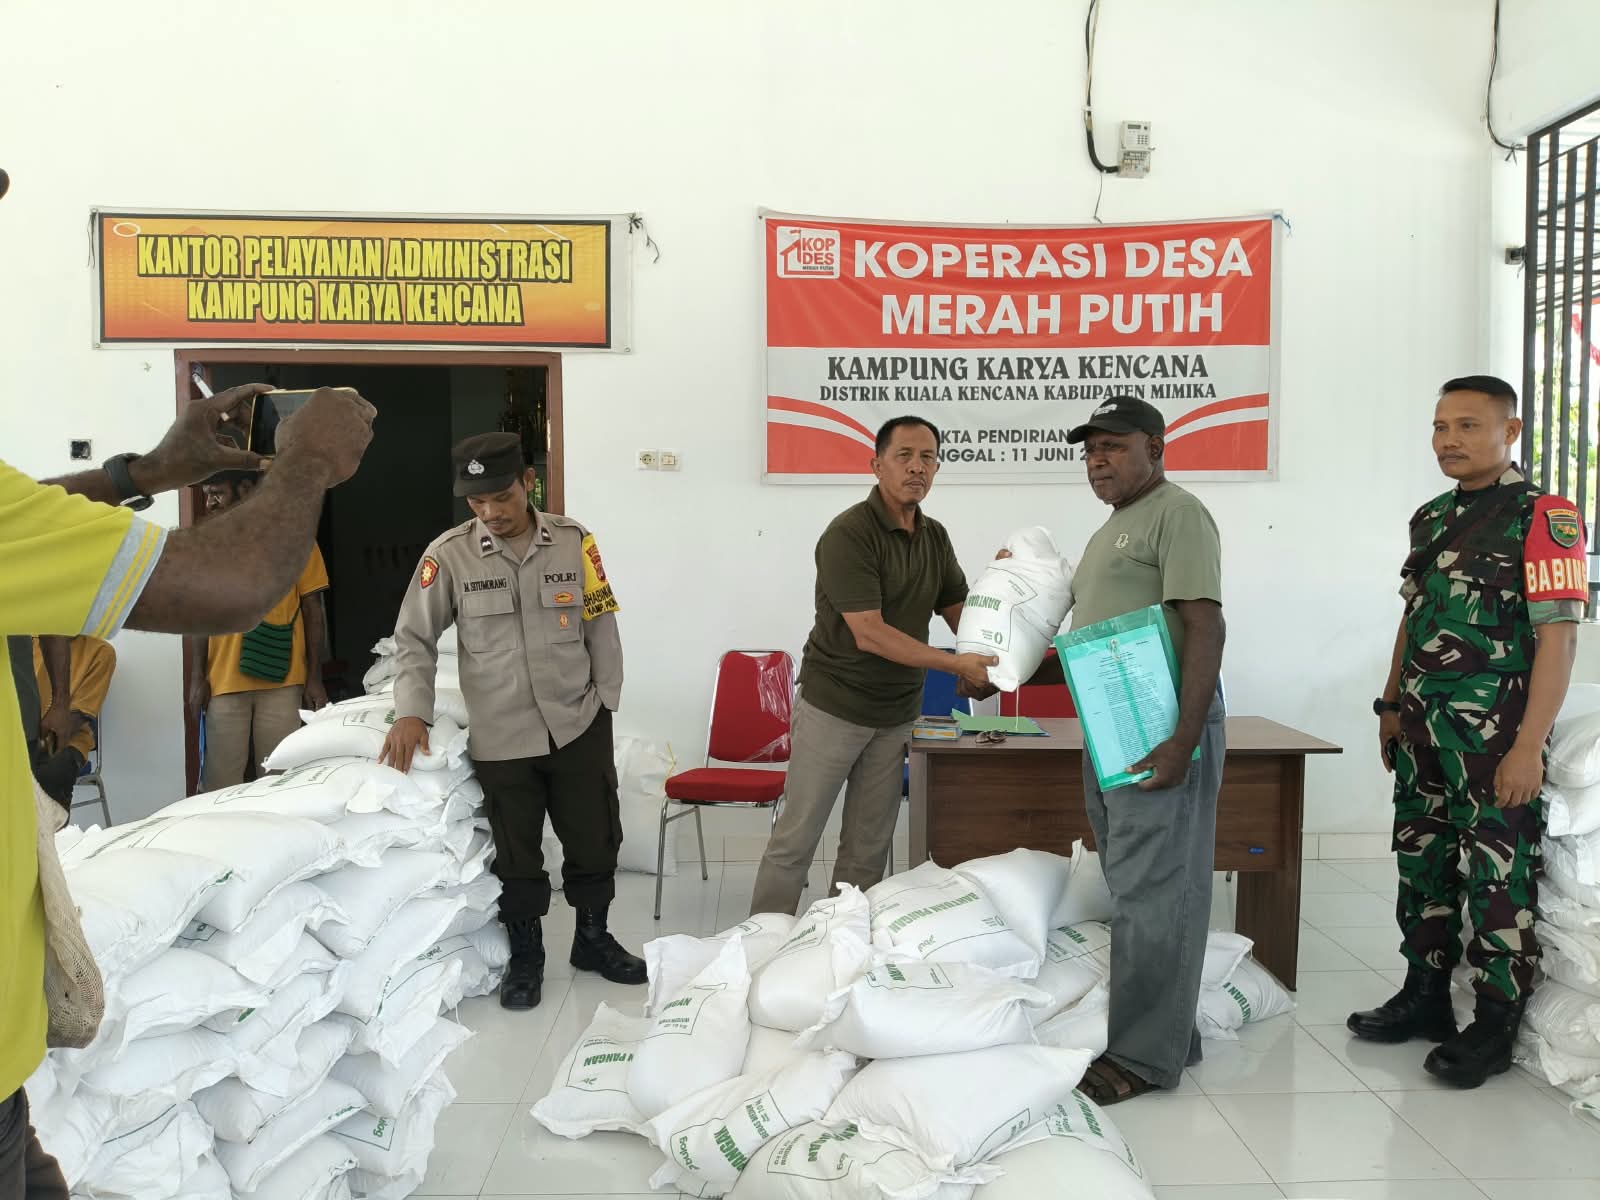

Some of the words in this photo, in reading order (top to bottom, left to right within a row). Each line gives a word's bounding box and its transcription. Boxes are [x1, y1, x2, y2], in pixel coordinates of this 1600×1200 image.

[802, 238, 836, 251] KOP
[137, 235, 241, 278] KANTOR
[243, 236, 383, 280] PELAYANAN
[386, 238, 572, 283] ADMINISTRASI
[802, 252, 835, 265] DES
[854, 239, 1106, 279] KOPERASI
[1124, 237, 1253, 278] DESA
[187, 281, 315, 322] KAMPUNG
[318, 282, 403, 324] KARYA
[405, 284, 524, 326] KENCANA
[881, 293, 1061, 335] MERAH
[1079, 292, 1223, 333] PUTIH
[827, 356, 970, 381] KAMPUNG
[976, 356, 1069, 381] KARYA
[1078, 354, 1209, 380] KENCANA
[820, 386, 890, 402] DISTRIK
[895, 386, 952, 402] KUALA
[957, 385, 1040, 402] KENCANA
[1044, 384, 1146, 401] KABUPATEN
[1152, 383, 1217, 400] MIMIKA
[940, 430, 972, 444] KTA
[978, 429, 1070, 443] PENDIRIAN
[938, 449, 995, 462] NGGAL
[1011, 448, 1027, 462] 11
[1034, 448, 1074, 462] JUNI
[544, 572, 577, 584] POLRI
[583, 1053, 627, 1067] PANGAN
